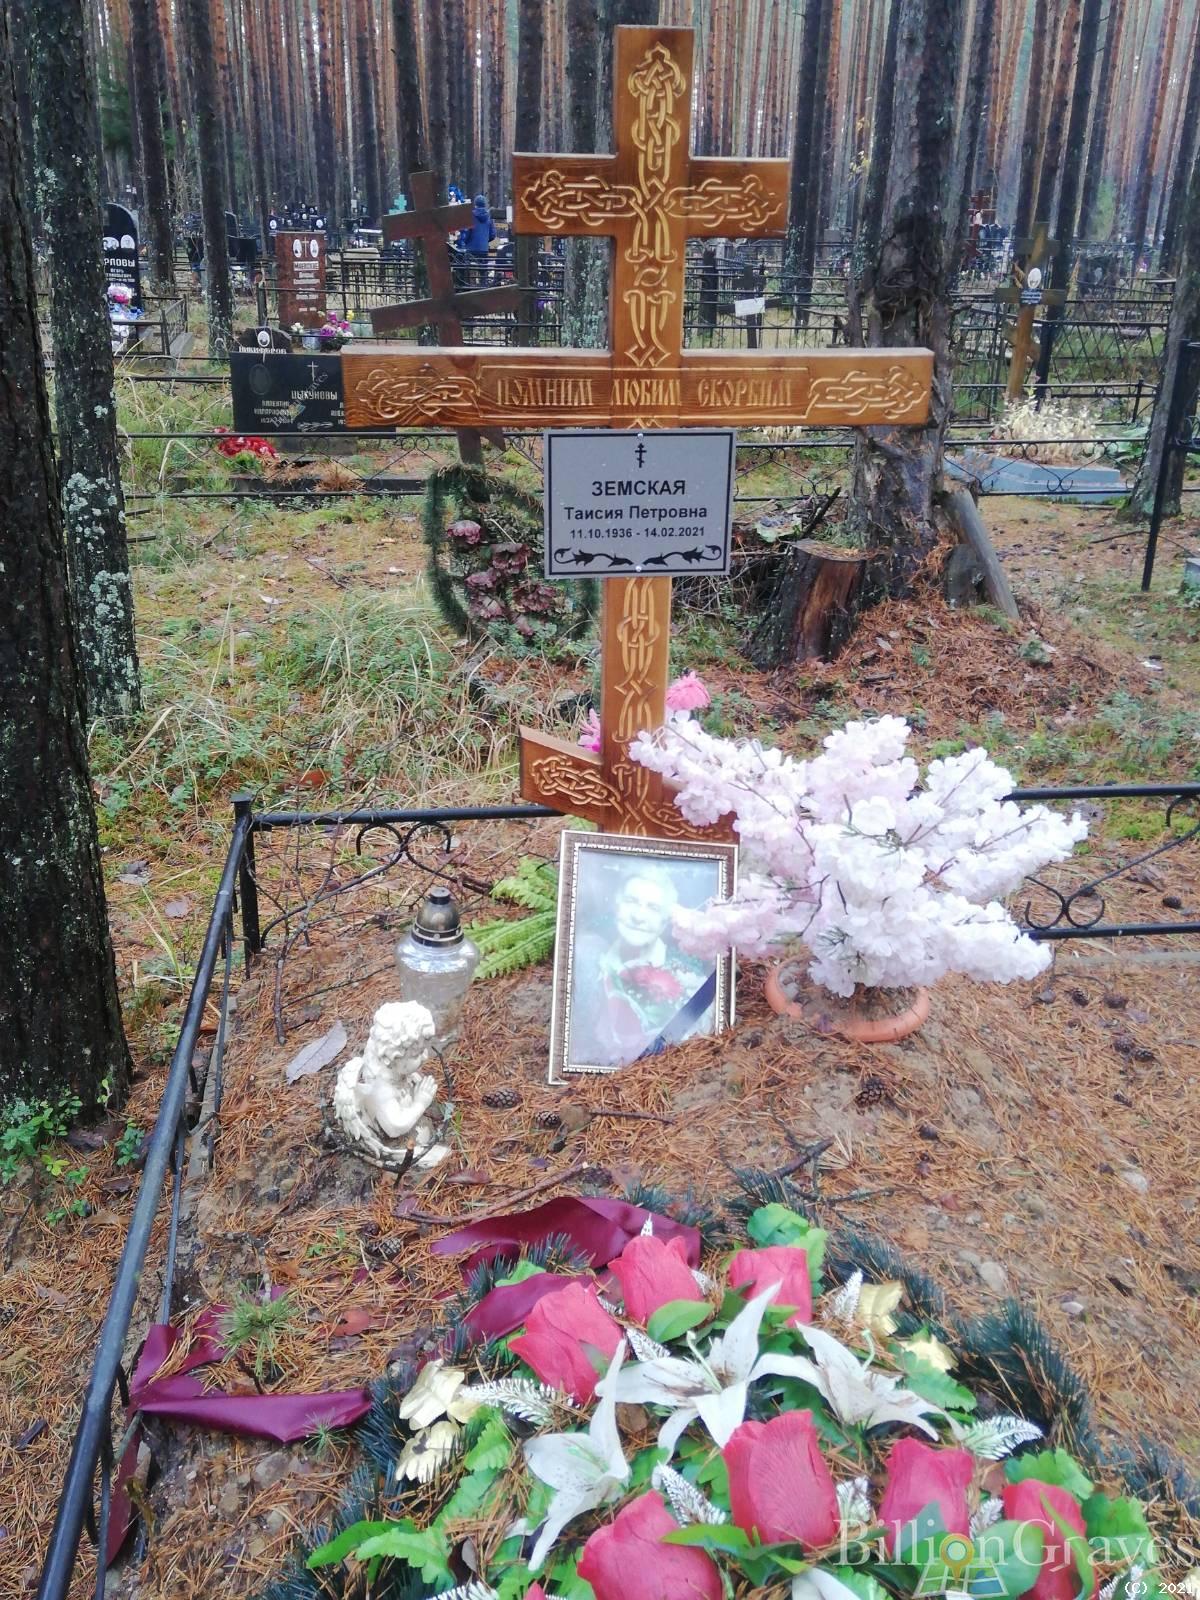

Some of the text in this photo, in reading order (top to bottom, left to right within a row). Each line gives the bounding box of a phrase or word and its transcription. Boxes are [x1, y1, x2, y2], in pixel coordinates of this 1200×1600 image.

[103, 258, 136, 267] РЛОВЫ
[495, 377, 792, 407] ПОМНИМ ЛЮБИМ СКОРБИМ
[591, 480, 686, 497] ЗЕМСКАЯ
[564, 505, 708, 522] Таисия Петровна
[570, 528, 633, 539] 11.10.1936
[644, 526, 705, 538] 14.02.2021
